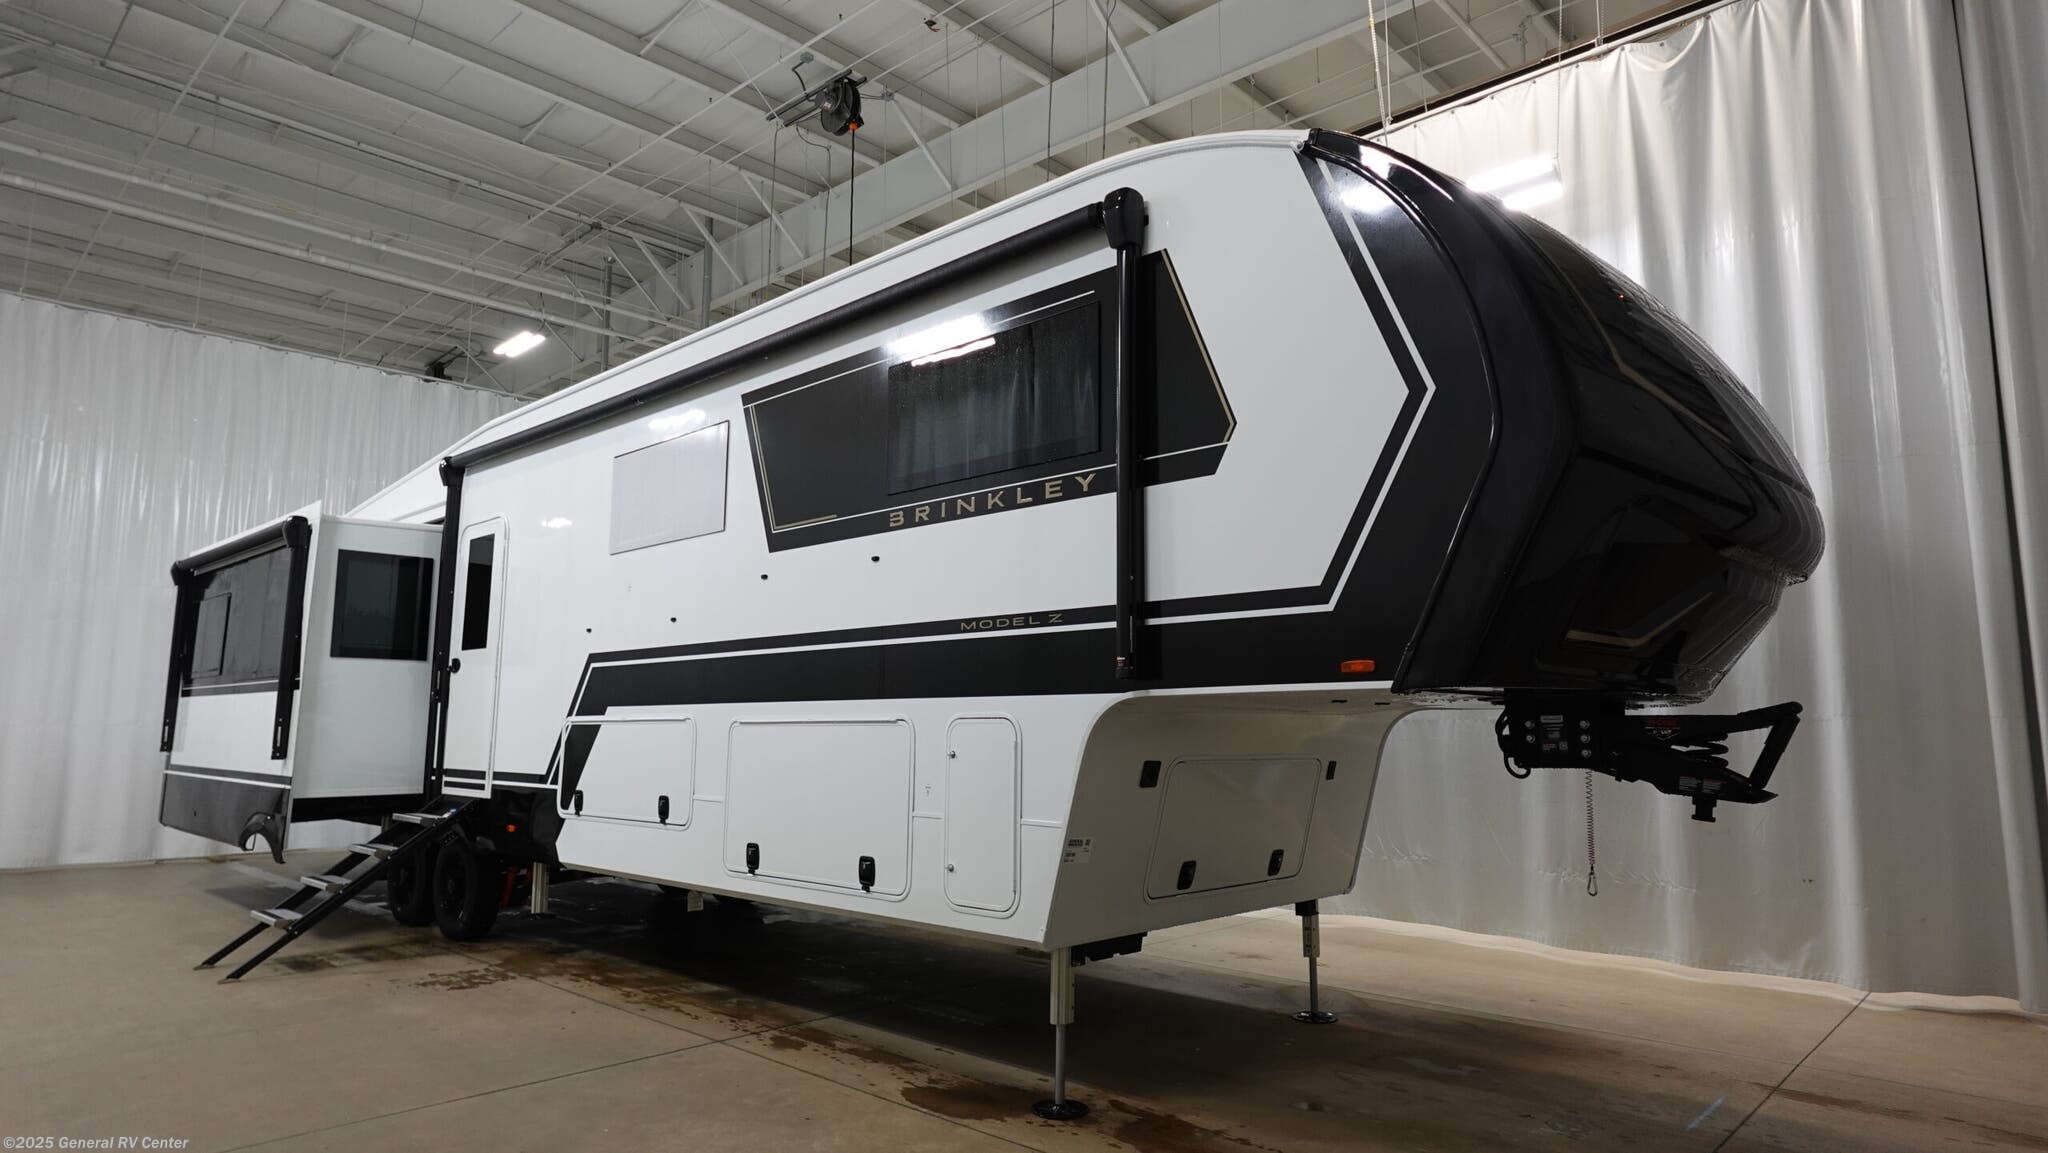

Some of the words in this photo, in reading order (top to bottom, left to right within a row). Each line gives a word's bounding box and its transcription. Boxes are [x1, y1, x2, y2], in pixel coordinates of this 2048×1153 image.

[889, 473, 1096, 528] BRINKLEY
[960, 614, 1041, 631] MODEL
[1048, 612, 1064, 624] Z
